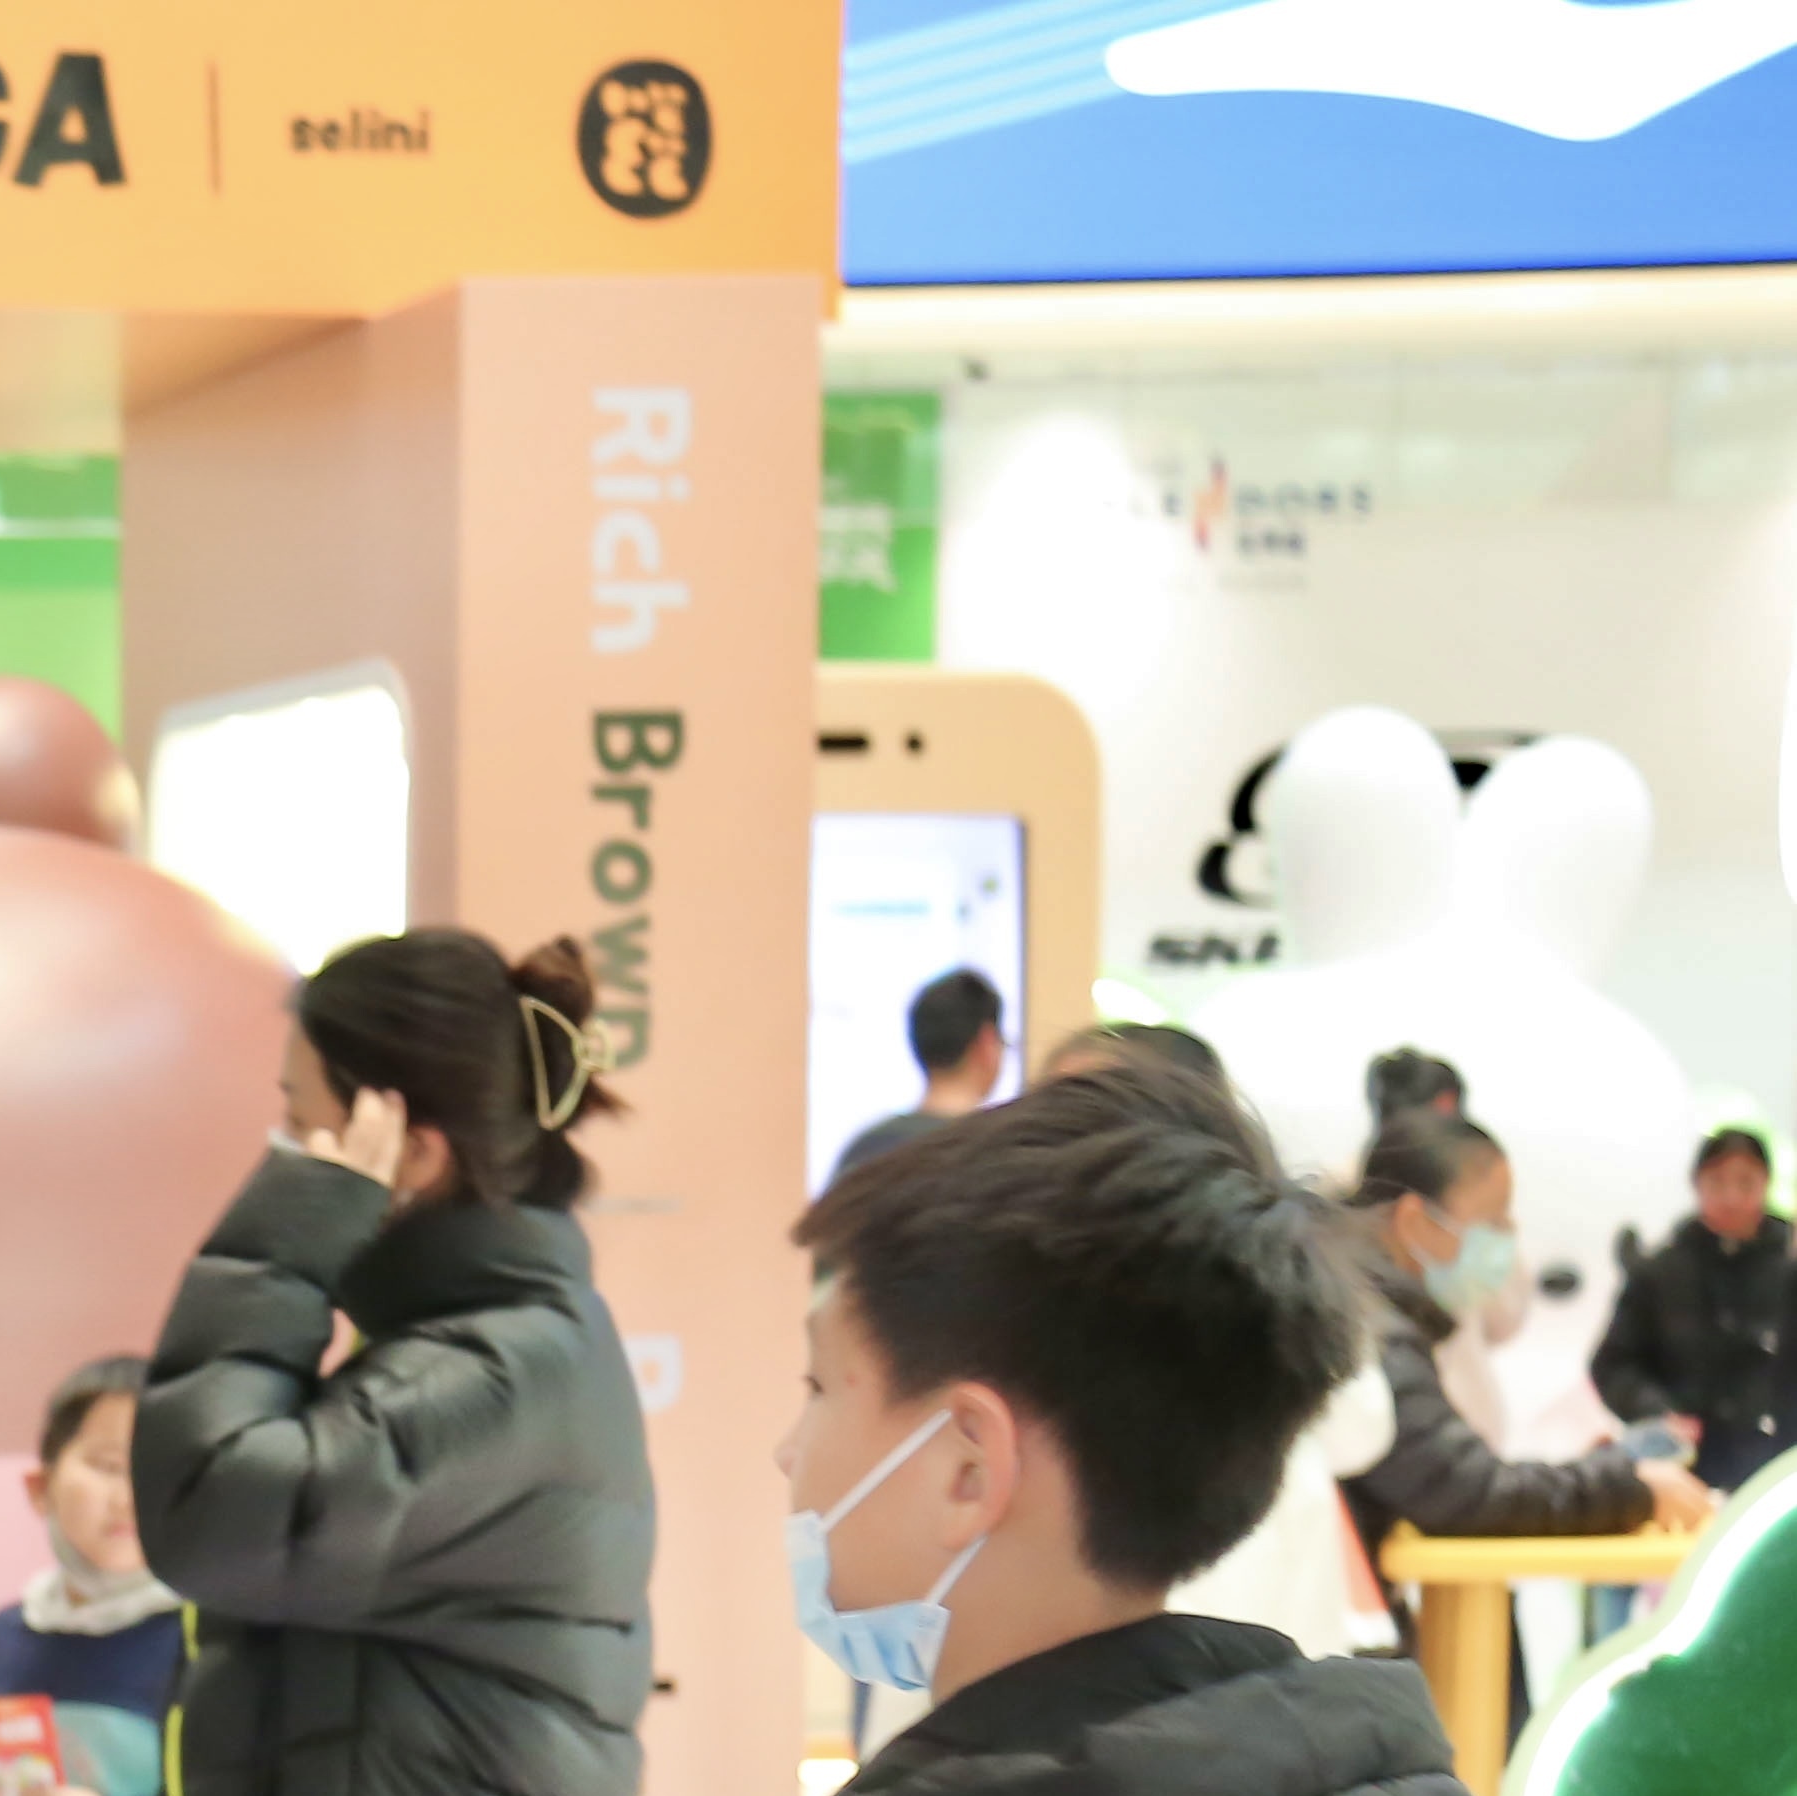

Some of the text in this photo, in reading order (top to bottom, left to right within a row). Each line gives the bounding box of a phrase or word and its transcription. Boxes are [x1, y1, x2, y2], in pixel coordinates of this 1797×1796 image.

[290, 110, 429, 153] selini
[590, 387, 691, 1069] Rich Brown
